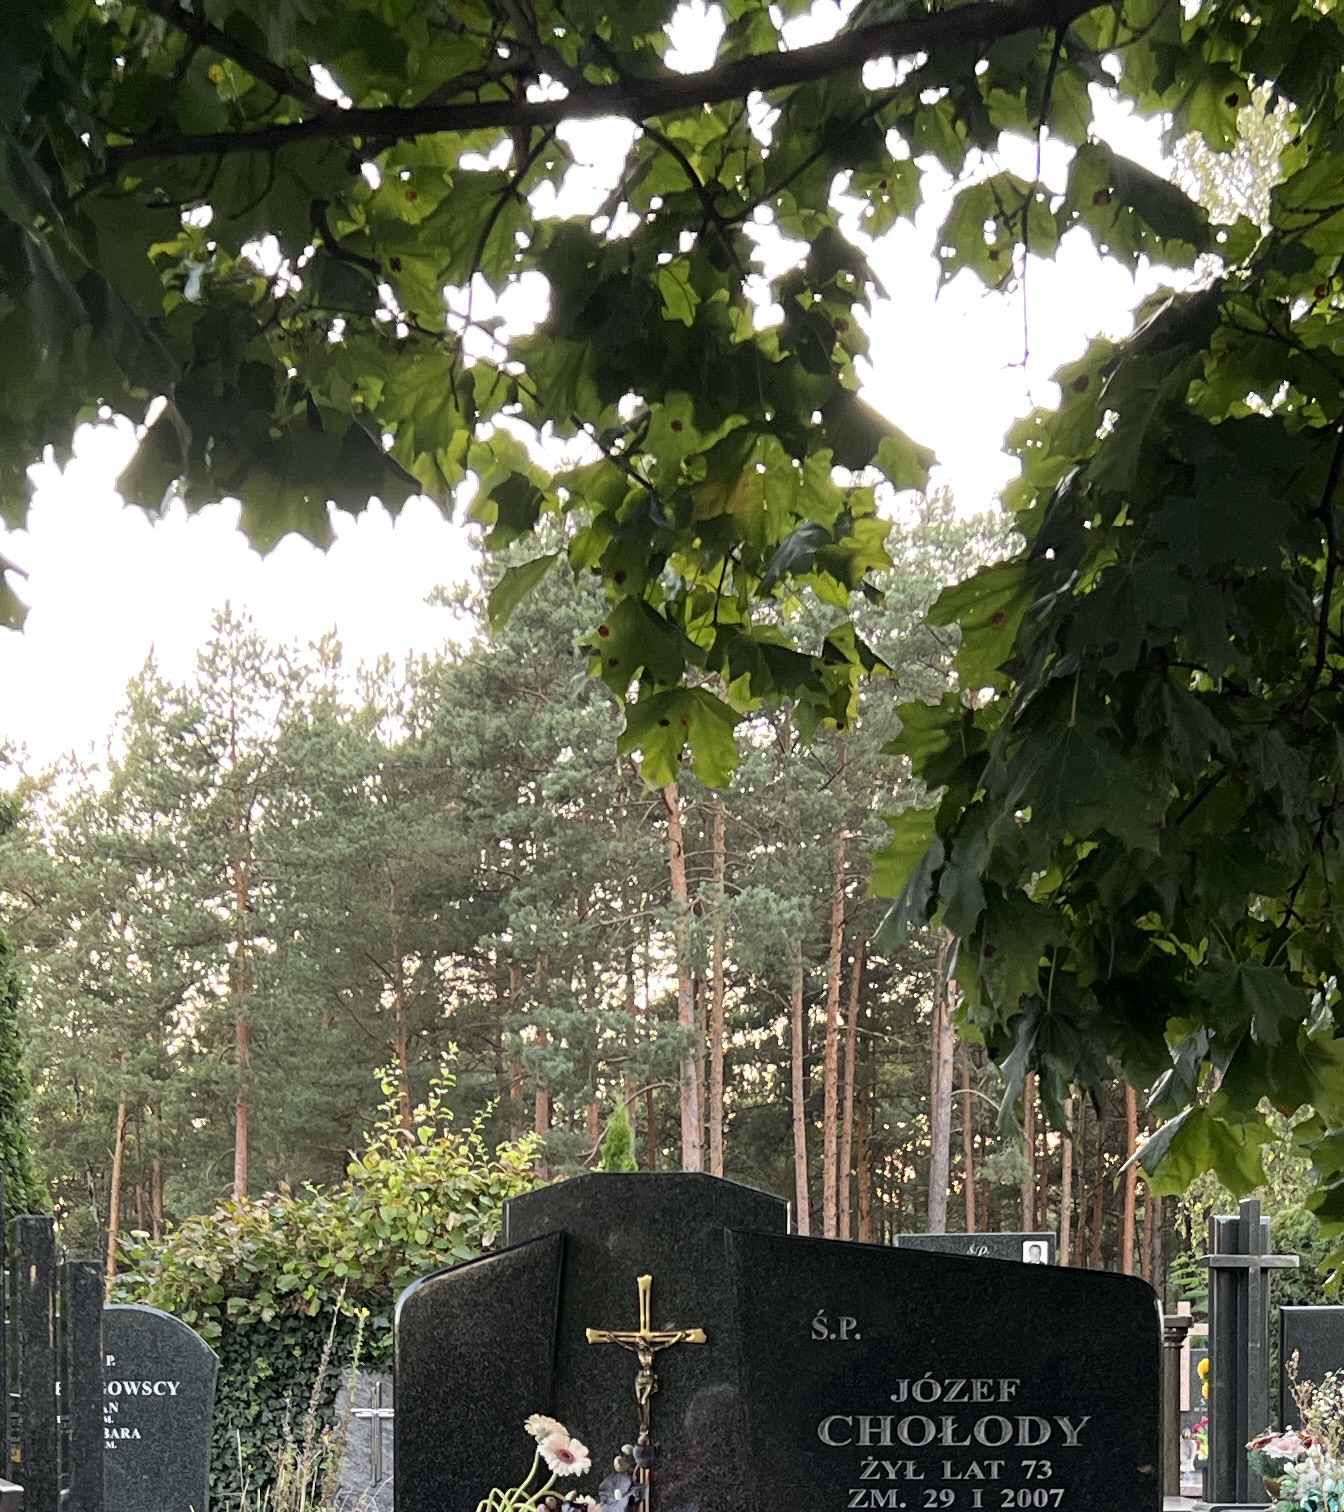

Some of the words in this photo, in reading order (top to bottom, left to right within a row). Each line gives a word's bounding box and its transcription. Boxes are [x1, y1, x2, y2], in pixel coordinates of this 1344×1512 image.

[811, 1309, 862, 1341] Ś.P.
[890, 1371, 1021, 1403] JÓZEF
[817, 1414, 1092, 1447] CHOŁODY
[859, 1456, 925, 1480] ŻYŁ
[941, 1460, 1005, 1480] LAT
[1020, 1460, 1053, 1480] 73
[847, 1488, 907, 1509] ZM.
[922, 1488, 956, 1509] 29
[971, 1488, 985, 1509] I
[1000, 1488, 1065, 1509] 2007
